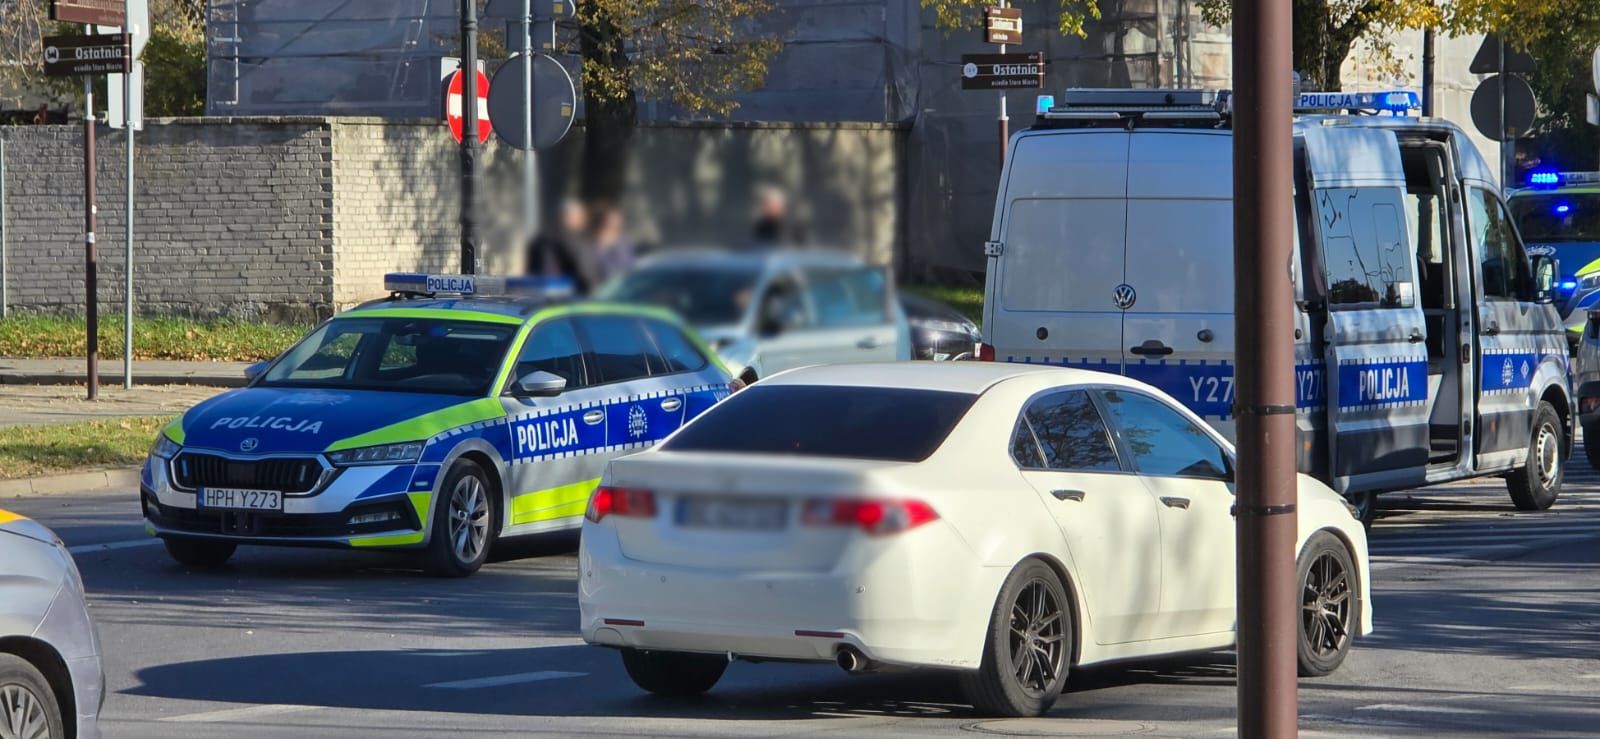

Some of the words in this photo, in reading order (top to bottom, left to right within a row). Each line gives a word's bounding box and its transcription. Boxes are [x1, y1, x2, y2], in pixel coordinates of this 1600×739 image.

[75, 46, 122, 60] Ostatnia
[992, 63, 1038, 76] Ostatnia
[1300, 94, 1353, 107] POLICJA
[427, 278, 473, 292] POLICJA
[1359, 366, 1409, 401] POLICJA
[210, 416, 323, 434] POLICJA
[516, 417, 579, 454] POLICJA
[206, 489, 234, 506] HPH
[241, 490, 278, 508] Y273
